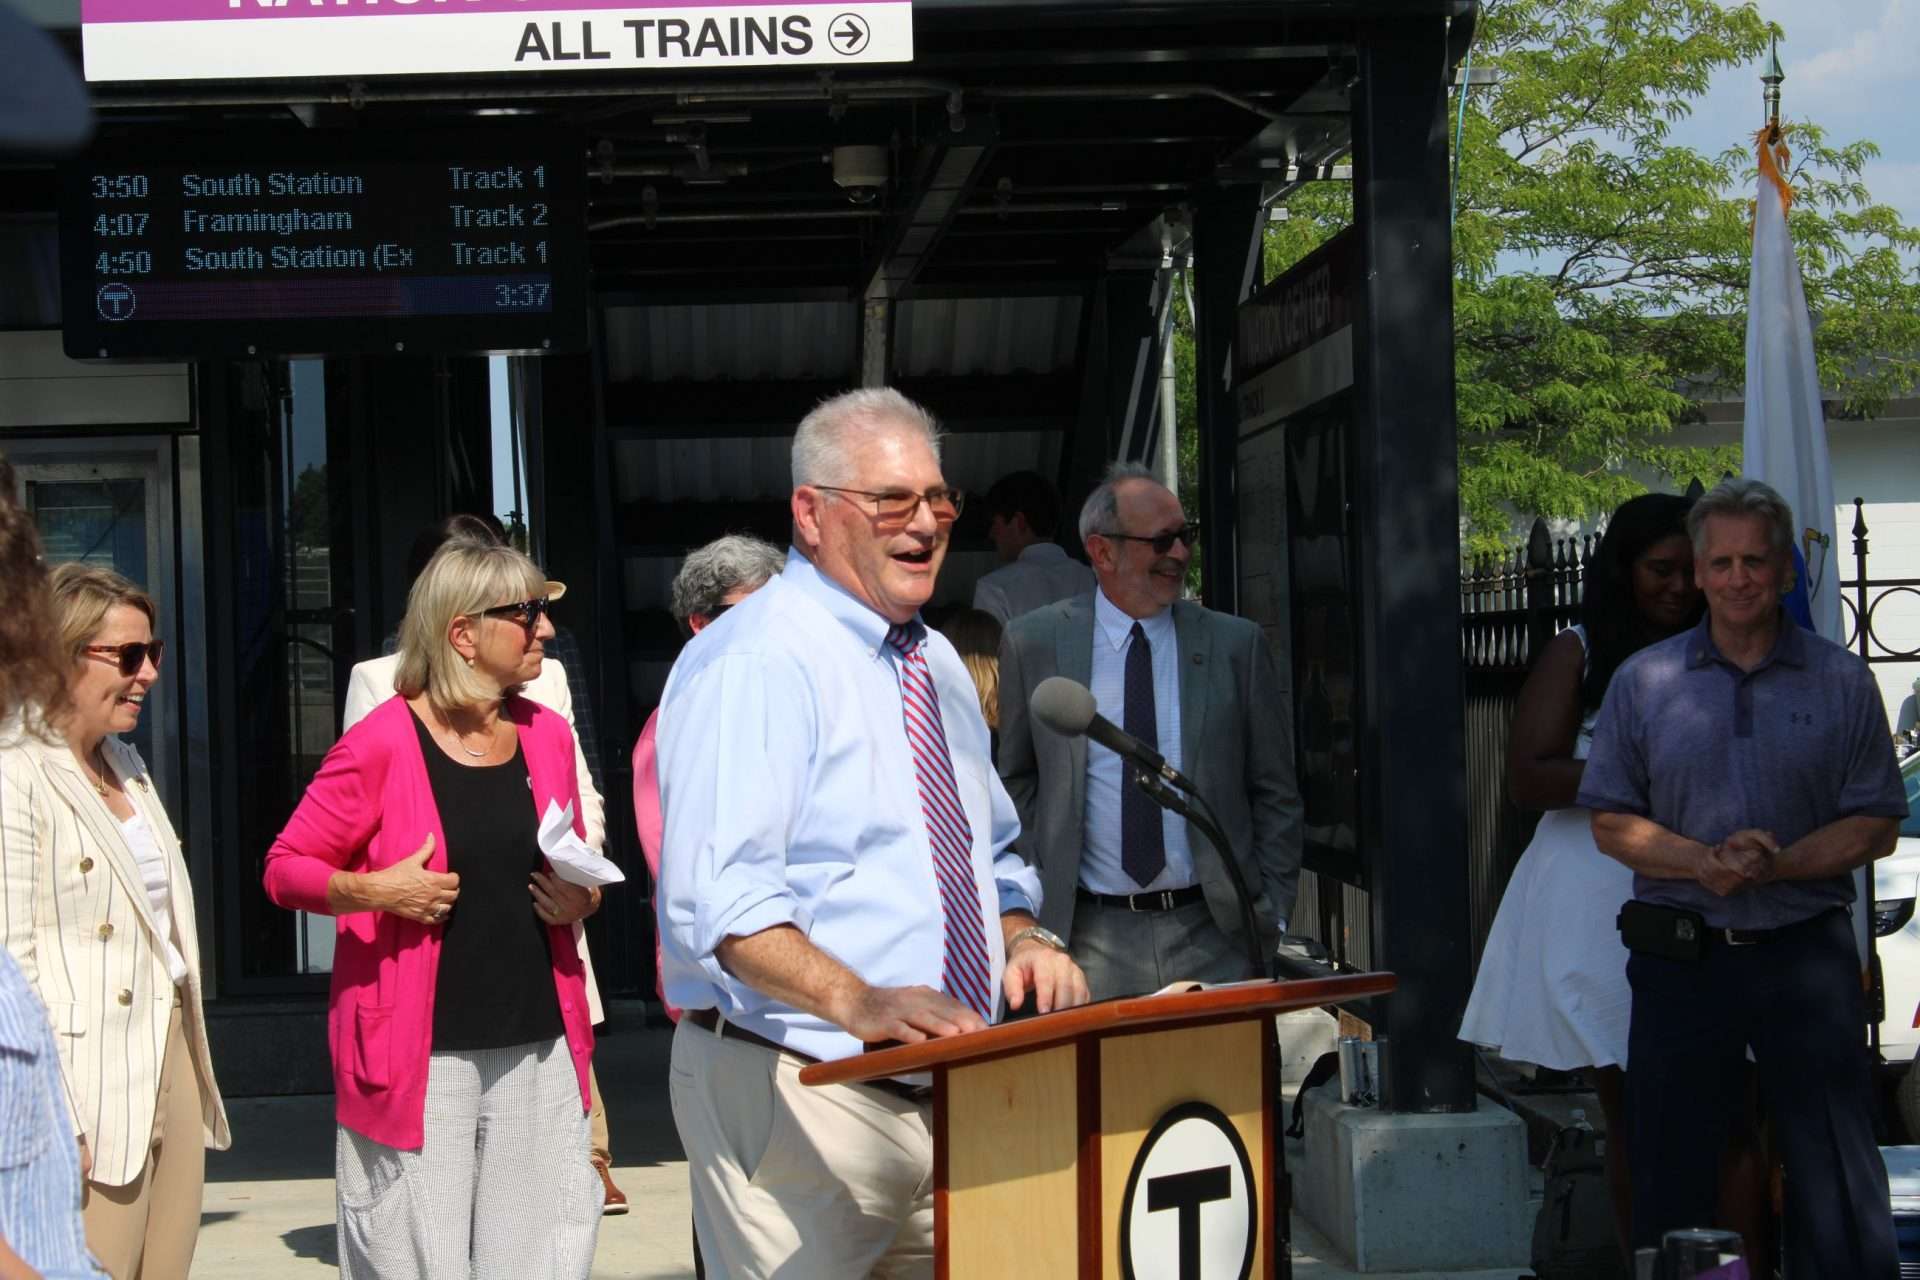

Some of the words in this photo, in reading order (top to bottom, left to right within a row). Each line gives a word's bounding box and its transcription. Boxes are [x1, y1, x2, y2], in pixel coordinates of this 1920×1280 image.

[515, 21, 611, 62] ALL
[624, 15, 813, 58] TRAINS
[92, 174, 149, 198] 3:50
[183, 173, 260, 197] South
[268, 171, 363, 195] Station
[449, 166, 523, 190] Track
[533, 165, 545, 188] 1
[93, 213, 150, 237] 4:07
[184, 208, 352, 236] Framingham
[450, 204, 525, 227] Track
[532, 203, 549, 226] 2
[95, 251, 151, 274] 4:50
[185, 247, 264, 270] South
[271, 245, 365, 269] Station
[451, 242, 526, 265] Track
[536, 241, 547, 265] 1
[495, 284, 550, 306] 3:37
[1147, 1164, 1232, 1280] T
